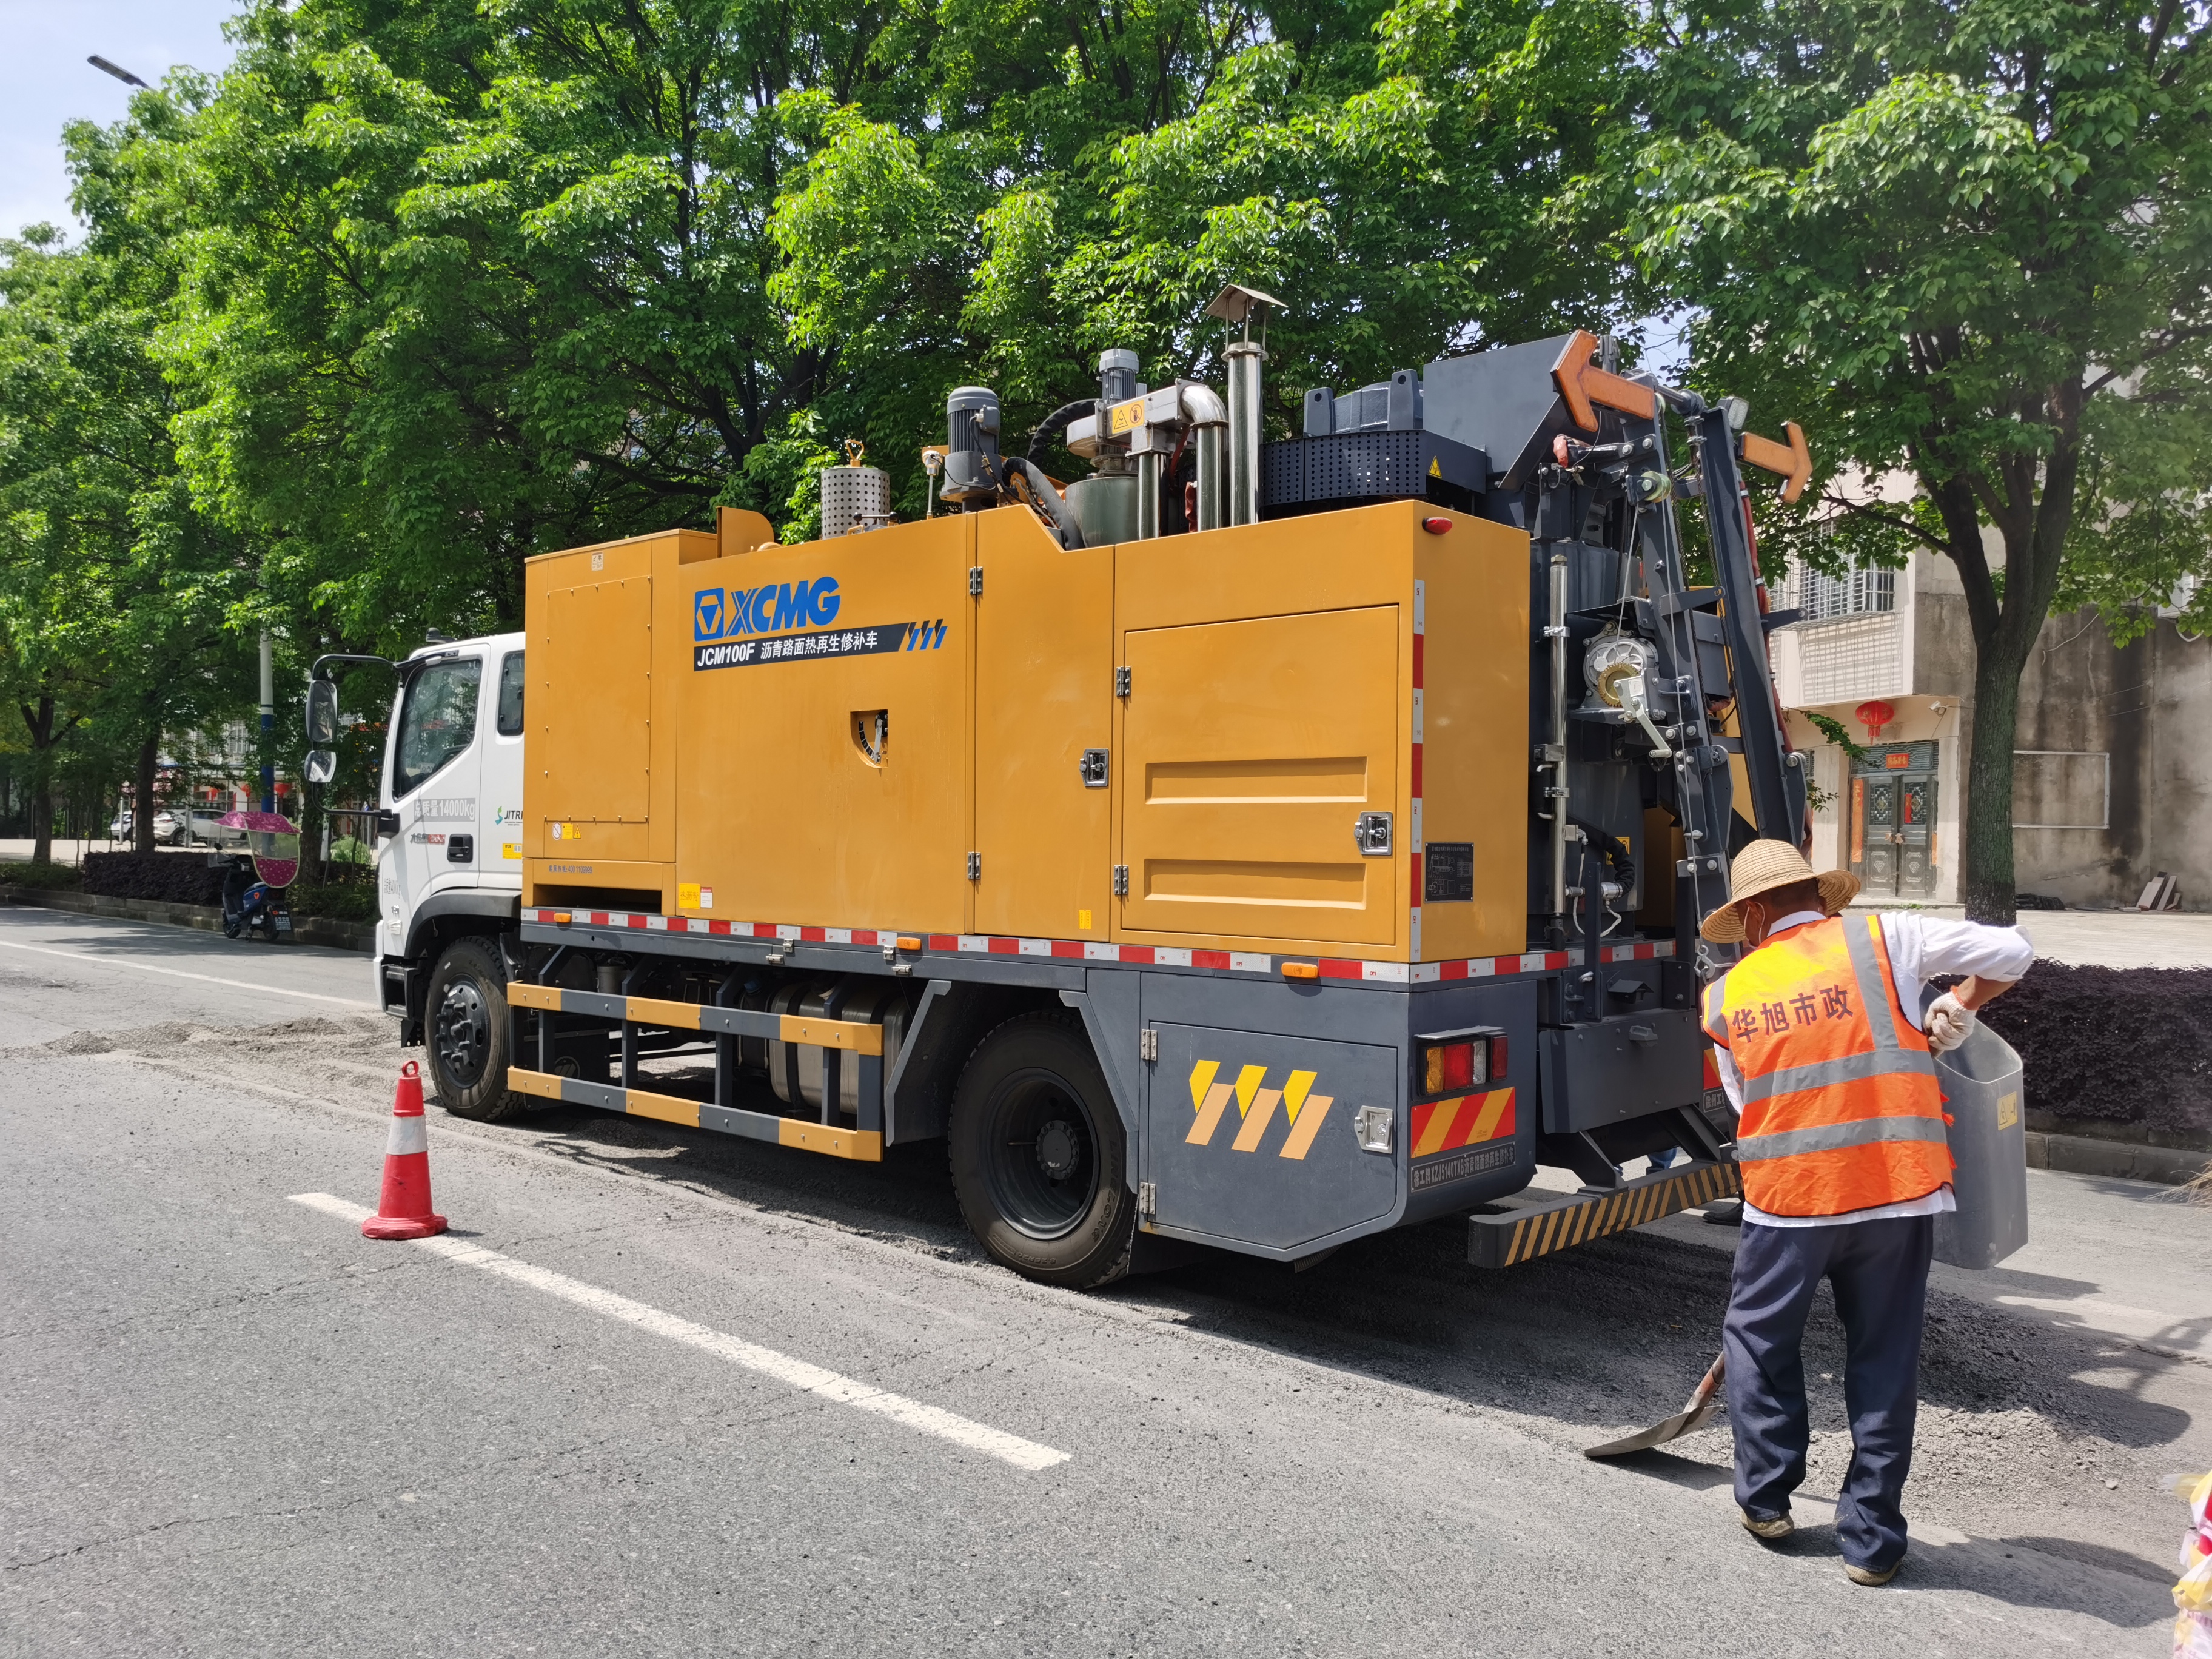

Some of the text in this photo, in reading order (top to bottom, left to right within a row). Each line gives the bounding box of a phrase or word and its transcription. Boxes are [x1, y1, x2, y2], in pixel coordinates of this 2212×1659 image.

[724, 576, 840, 637] XCMG
[697, 631, 878, 667] JCM100F 沥青路面热再生修补车
[680, 890, 699, 902] 热沥青
[1732, 984, 1853, 1043] 华旭市政
